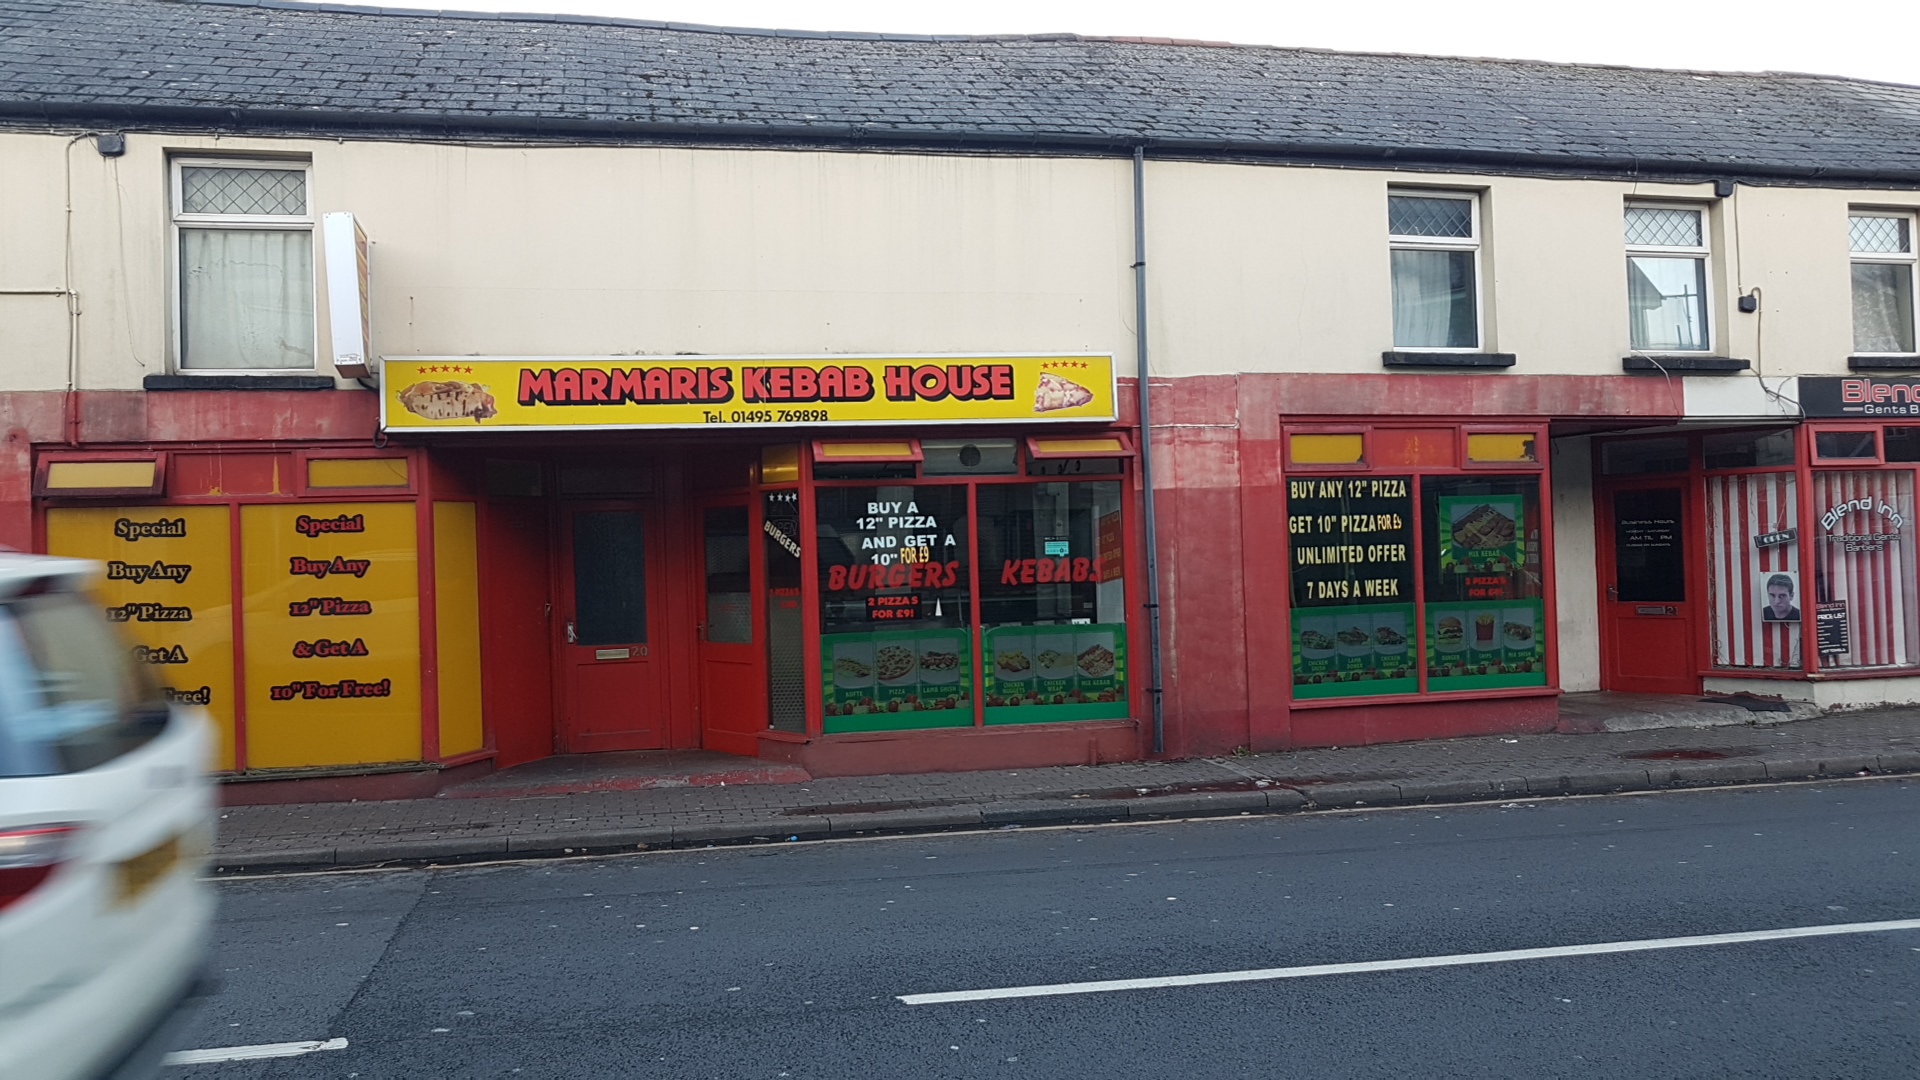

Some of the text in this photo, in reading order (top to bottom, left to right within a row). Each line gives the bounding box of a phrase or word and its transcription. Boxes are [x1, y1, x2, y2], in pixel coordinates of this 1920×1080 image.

[517, 365, 1015, 406] MARMARIS KEBAB HOUSE
[703, 409, 828, 423] Tel. 01495 769898
[1864, 404, 1907, 414] Gents
[1291, 481, 1315, 499] BUY
[1319, 480, 1343, 498] ANY
[1371, 480, 1406, 497] PIZZA
[867, 502, 919, 514] BUY A
[1821, 496, 1903, 531] Blend Inn
[115, 518, 186, 541] Special
[295, 514, 364, 538] Special
[888, 516, 937, 528] PIZZA
[1289, 516, 1312, 533] GET
[1341, 515, 1376, 532] PIZZA
[1377, 514, 1392, 530] FOR
[764, 520, 801, 558] BURGERS
[862, 534, 956, 549] AND GET A
[900, 547, 917, 564] FOR
[919, 546, 930, 563] £9
[1297, 544, 1406, 564] UNLIMITED OFFER
[107, 560, 191, 584] Buy Any
[290, 556, 370, 579] Buy Any
[828, 561, 959, 591] BURGERS
[1001, 556, 1106, 585] KEBABS
[1307, 579, 1399, 599] 7 DAYS A WEEK
[319, 597, 372, 615] Pizza
[868, 597, 875, 606] 2
[137, 603, 192, 621] Pizza
[872, 610, 893, 618] FOR
[169, 645, 188, 663] A
[293, 638, 369, 658] & Get A
[303, 681, 340, 699] For
[339, 678, 391, 698] Free!
[845, 690, 863, 698] KOFTE
